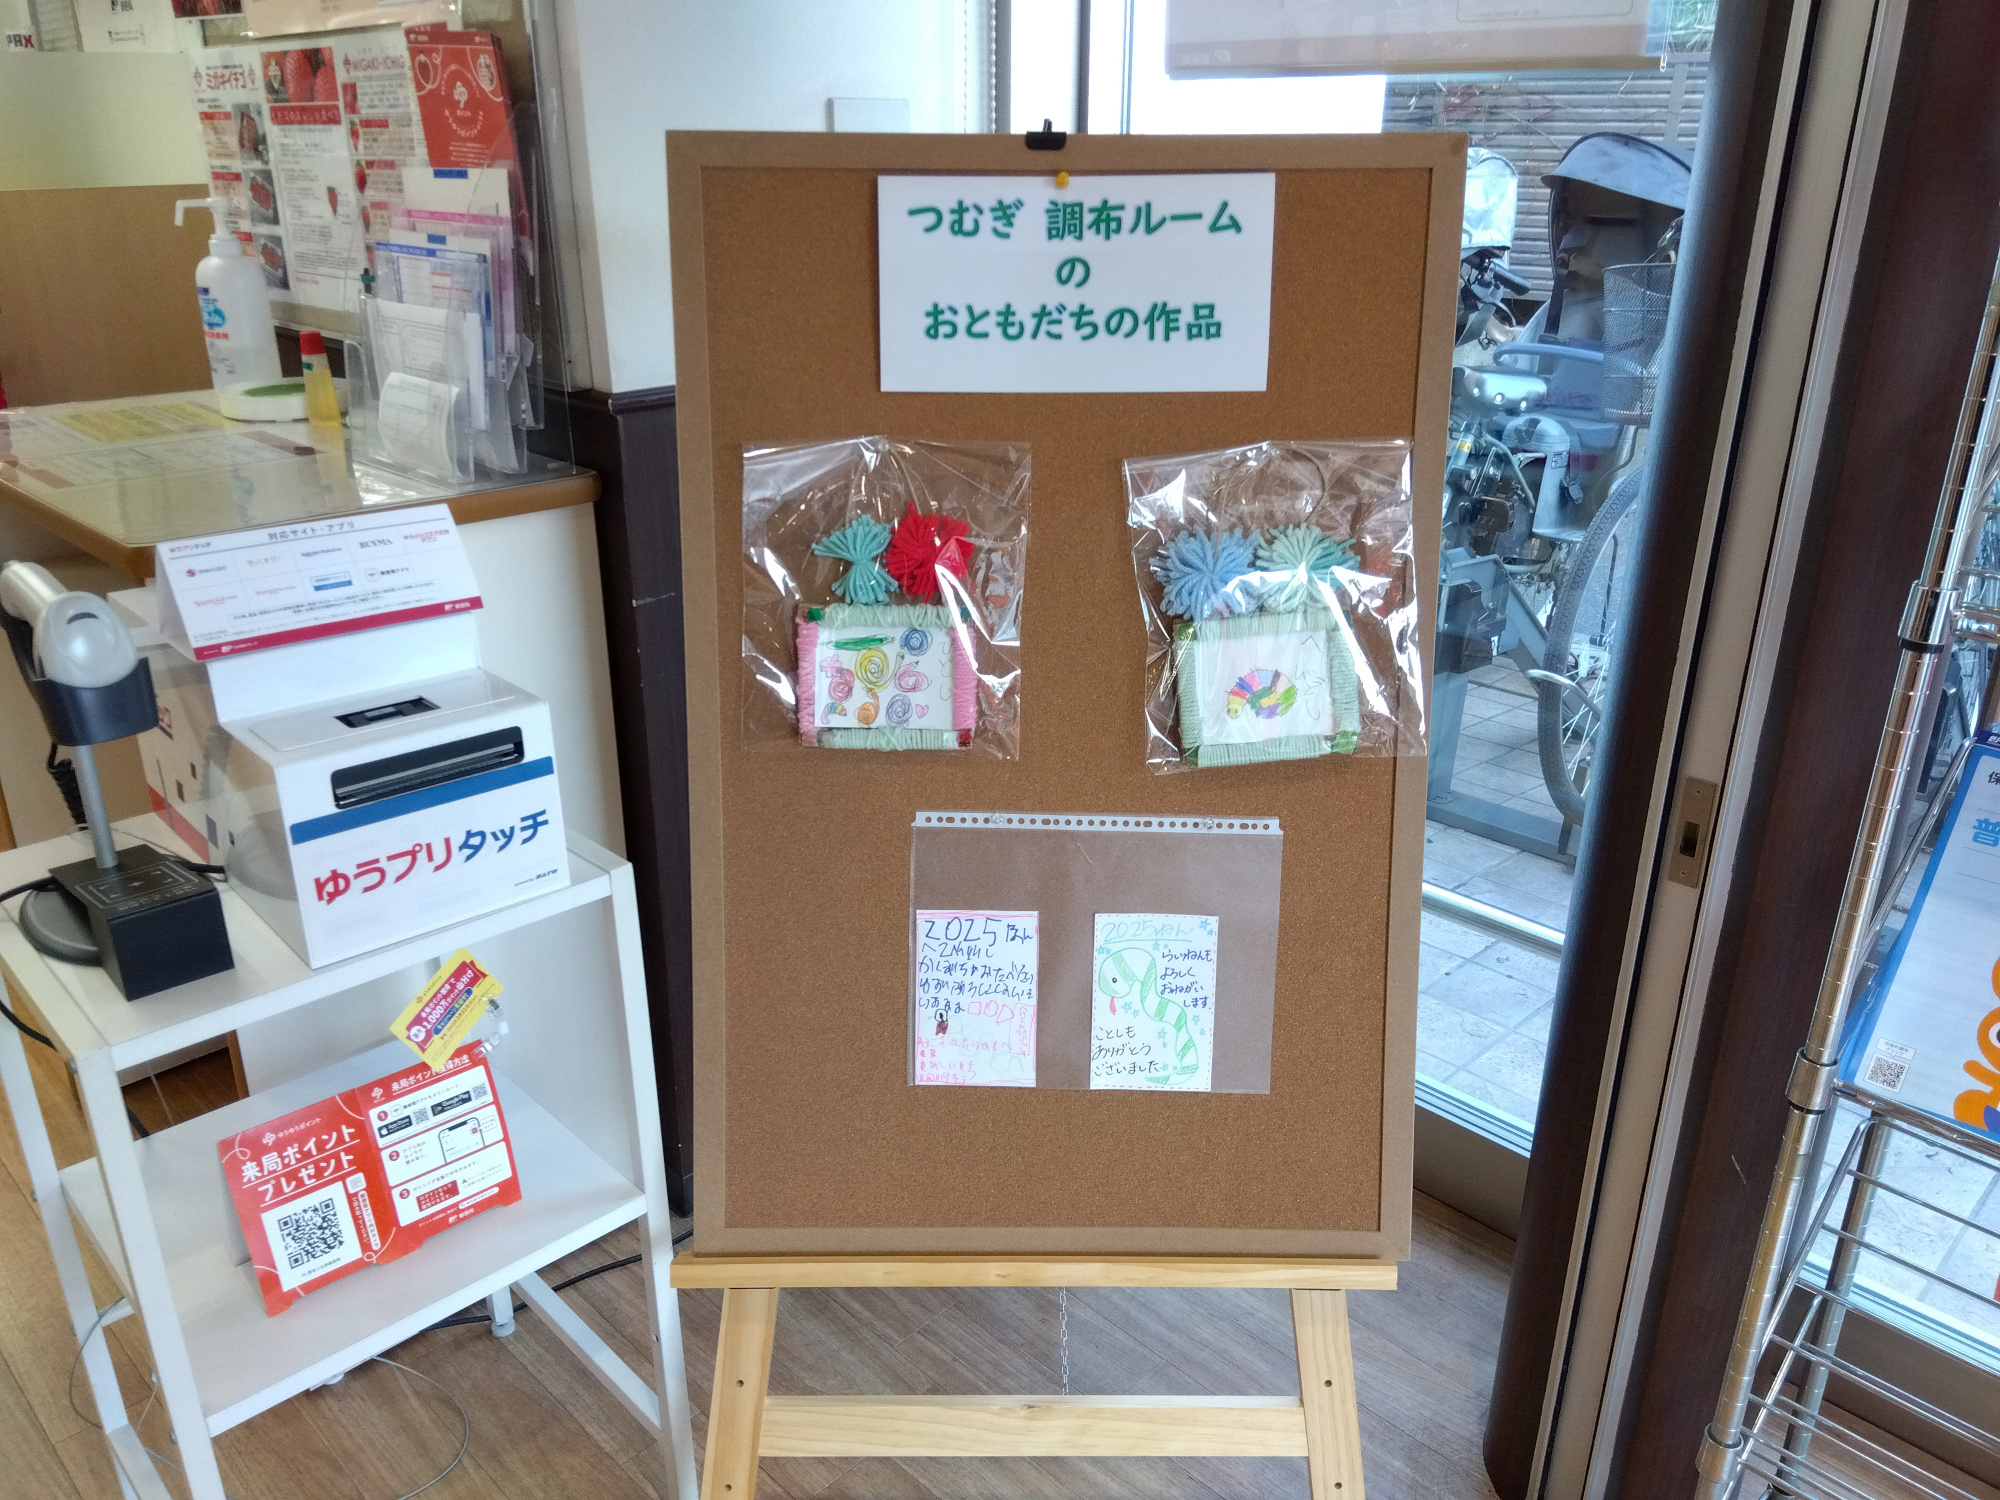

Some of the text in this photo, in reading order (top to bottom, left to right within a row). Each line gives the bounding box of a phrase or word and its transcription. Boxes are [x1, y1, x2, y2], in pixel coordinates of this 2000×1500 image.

[907, 198, 1243, 241] つむぎ 調布ルーム
[1056, 256, 1091, 288] の
[924, 301, 1223, 342] おともだちの作品
[268, 521, 355, 541] 対応サイト・アプリ
[358, 538, 393, 549] BUYMA
[313, 808, 549, 906] ゆうプリタッチ
[1101, 919, 1194, 943] 2025ねん
[1161, 948, 1213, 964] らいねんも
[1160, 967, 1196, 981] よろしく
[1183, 995, 1209, 1009] します
[1095, 1026, 1136, 1041] ことしも
[1092, 1042, 1151, 1060] ありがとう
[1094, 1060, 1160, 1077] ございました
[277, 1117, 322, 1139] ゆうゆうポイント
[241, 1124, 356, 1184] 来局ポイント
[258, 1151, 354, 1203] プレゼント
